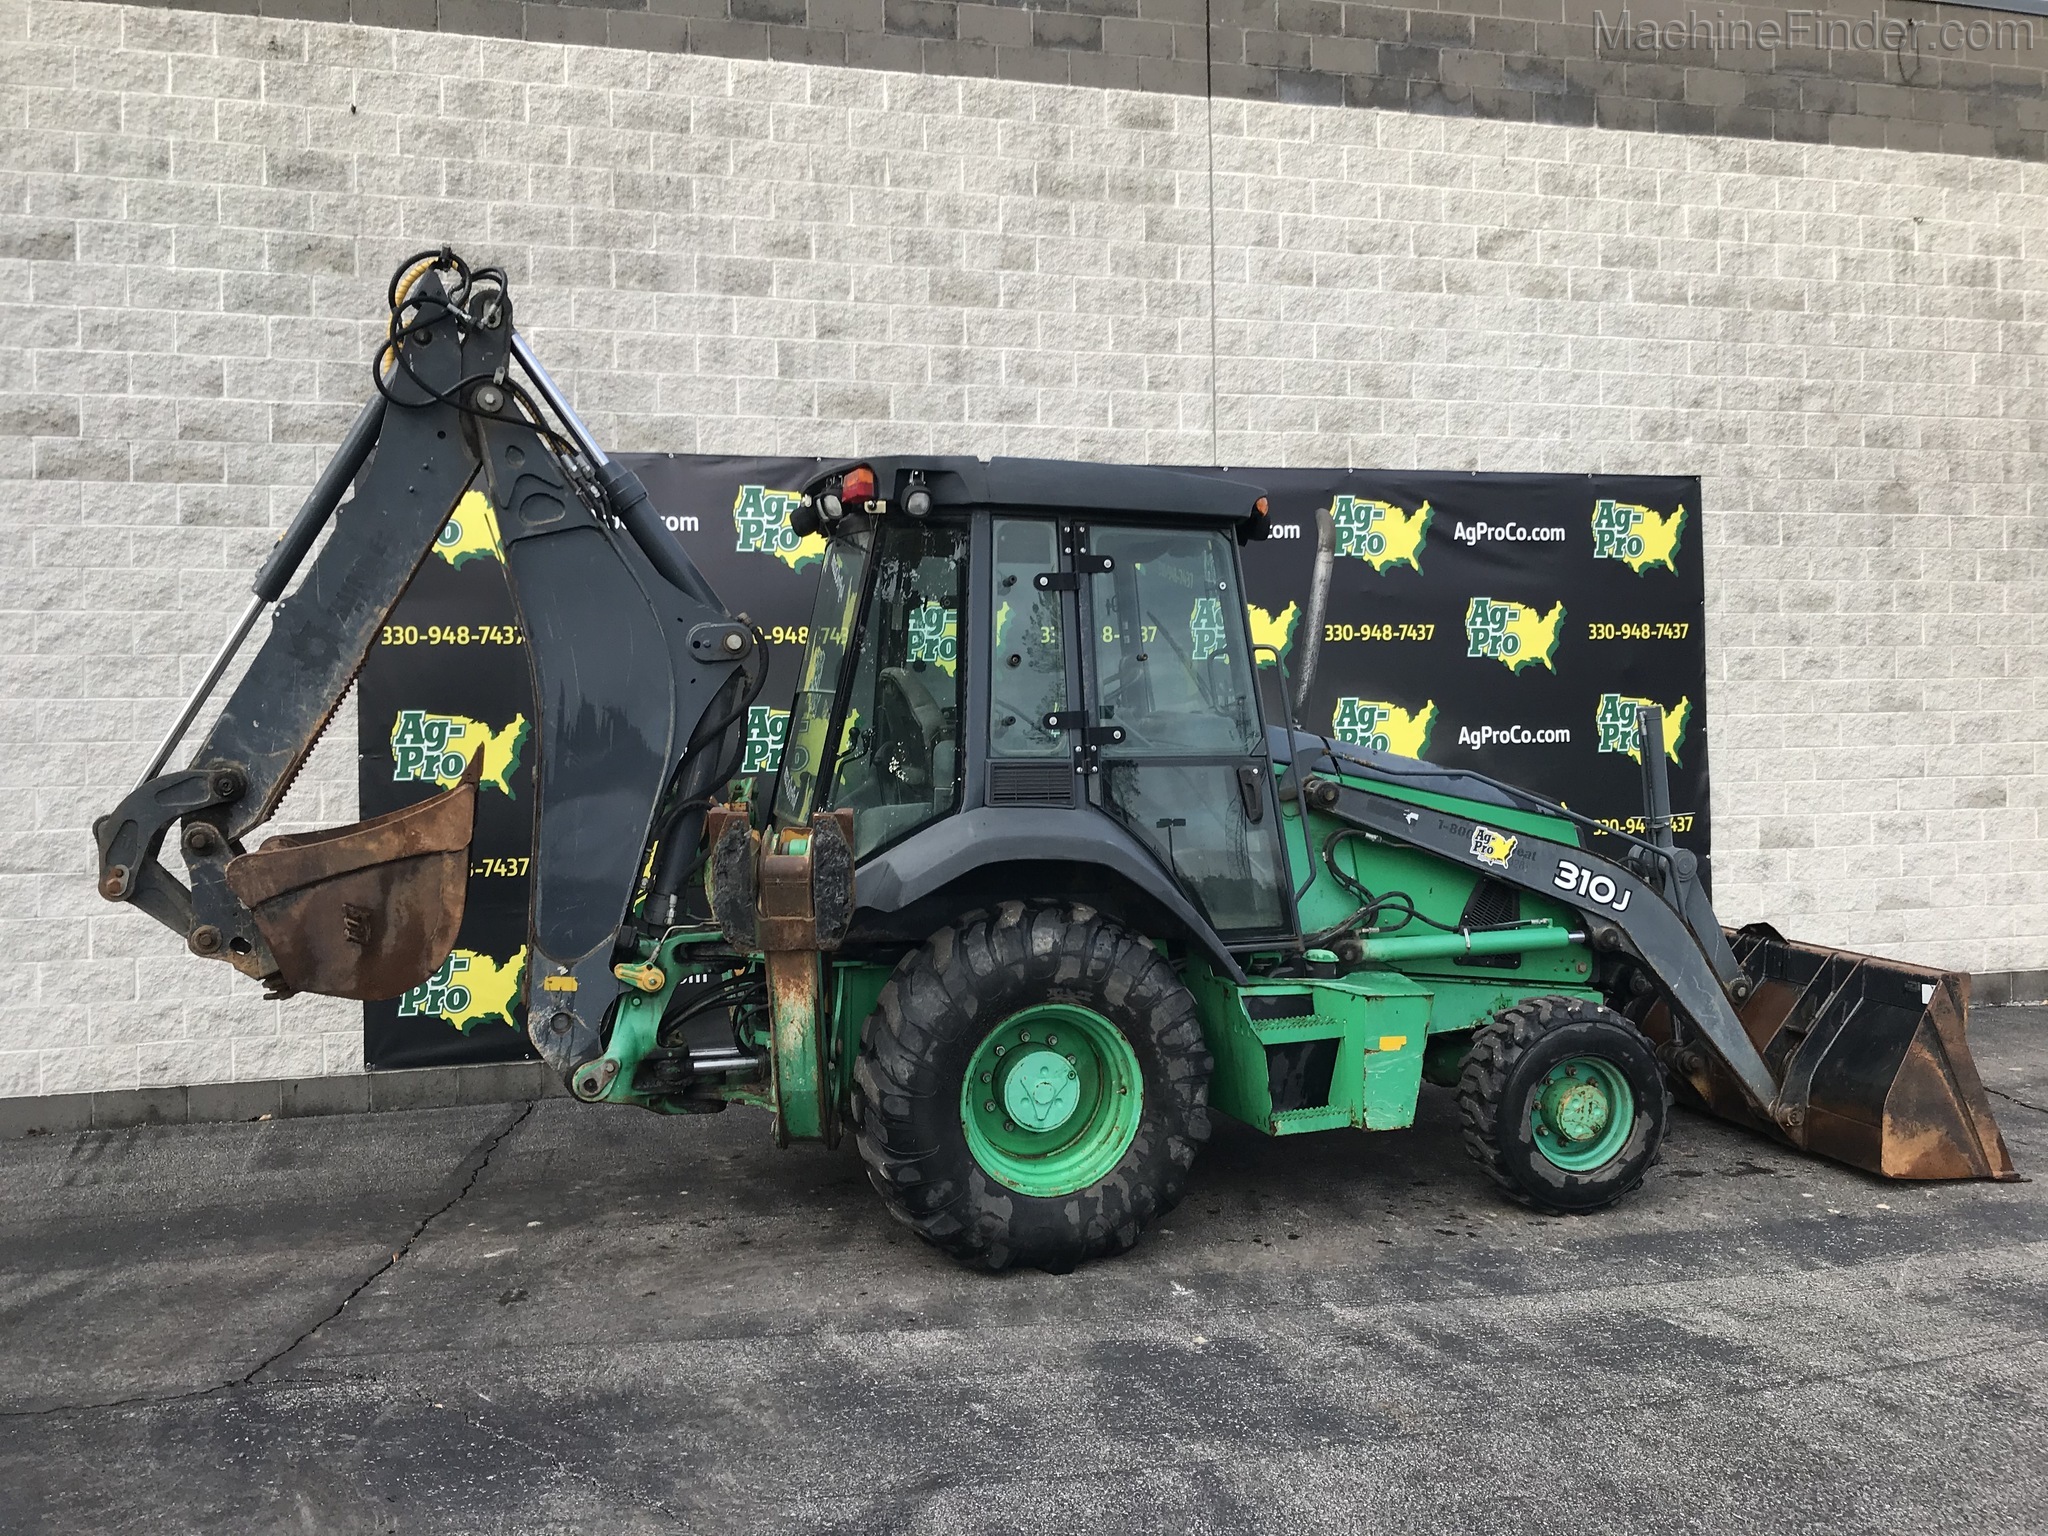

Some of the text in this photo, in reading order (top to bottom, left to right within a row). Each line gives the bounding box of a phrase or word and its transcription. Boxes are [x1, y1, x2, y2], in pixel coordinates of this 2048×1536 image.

[1333, 495, 1385, 533] Ag-
[1593, 499, 1644, 536] Ag-
[735, 518, 802, 552] Pro
[1334, 525, 1386, 556] Pro
[1453, 521, 1566, 546] AgProCo.com
[1593, 529, 1644, 558] Pro
[1467, 597, 1520, 634] Ag-
[1588, 623, 1689, 640] 330-948-7437
[906, 629, 957, 662] Pro
[1324, 624, 1434, 642] 330-948-7437
[1467, 628, 1520, 657] Pro
[393, 710, 466, 752] Ag-
[1334, 697, 1389, 733] Ag-
[1458, 725, 1570, 750] AgProCo.com
[393, 745, 467, 781] Pro
[1473, 841, 1494, 855] Pro
[1475, 829, 1496, 844] Ag-
[1552, 859, 1633, 913] 310J
